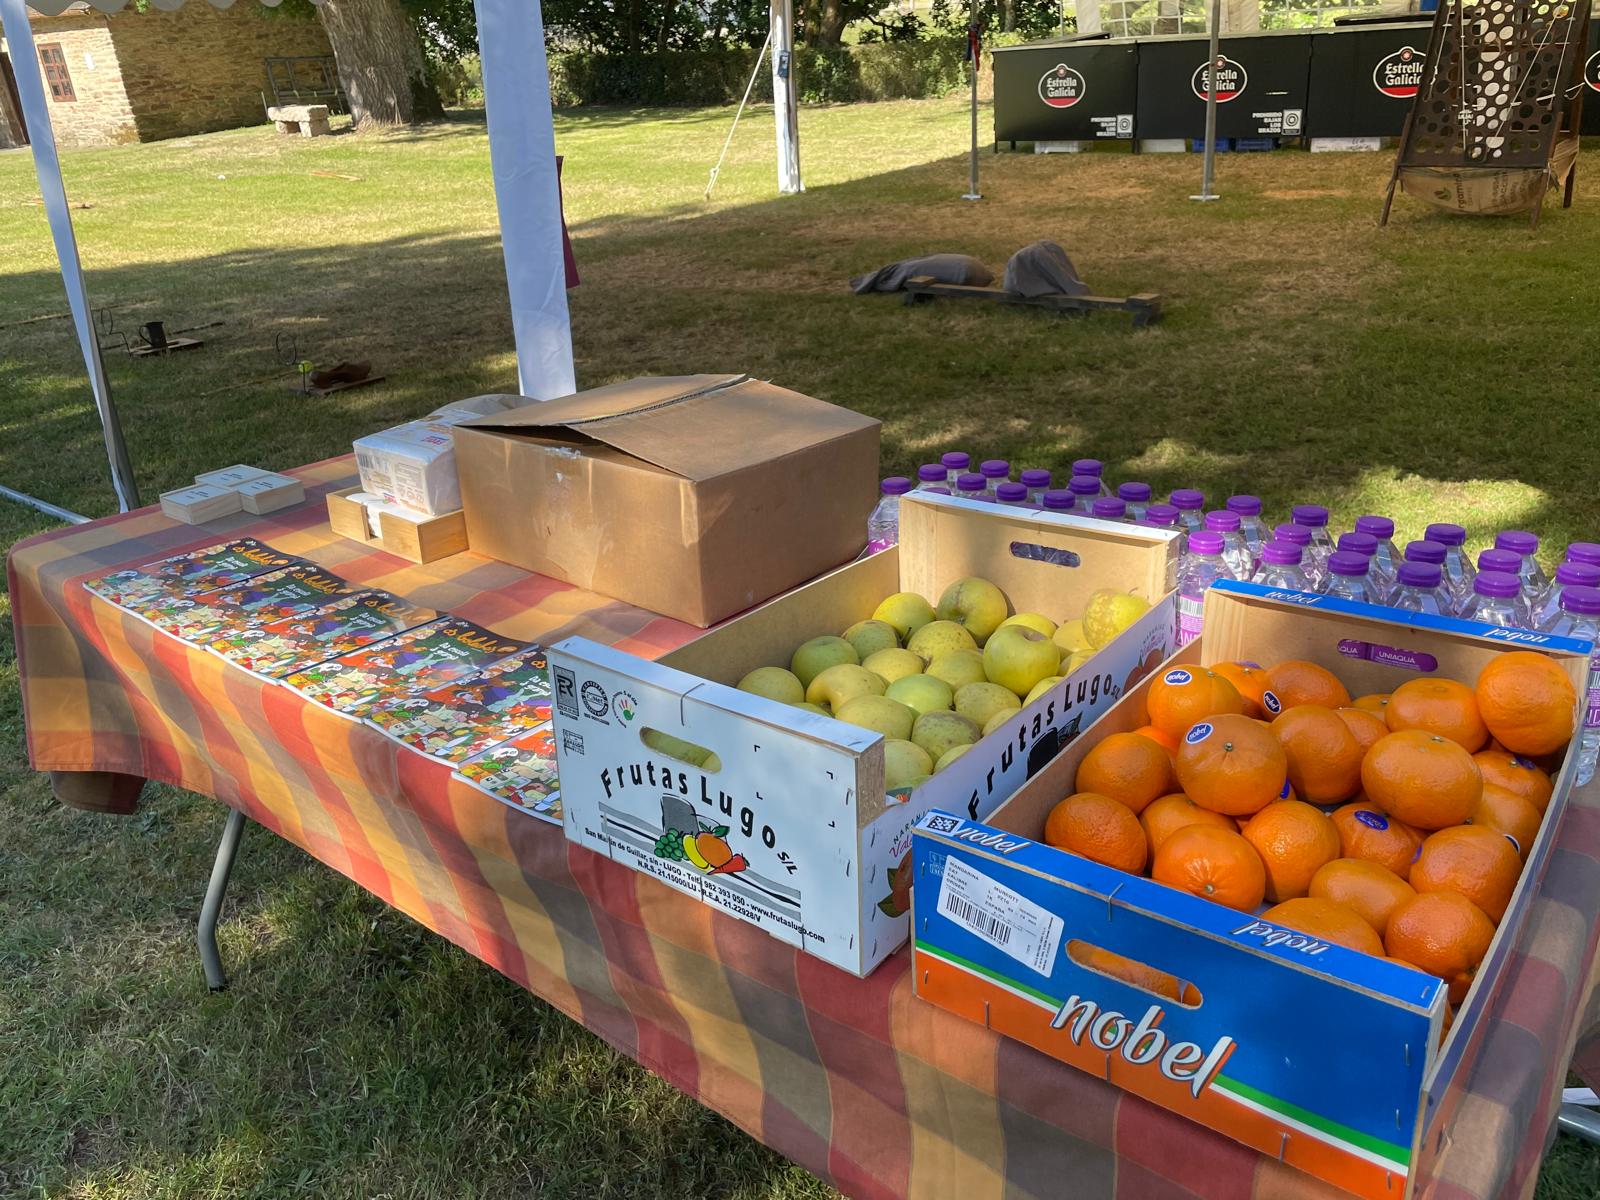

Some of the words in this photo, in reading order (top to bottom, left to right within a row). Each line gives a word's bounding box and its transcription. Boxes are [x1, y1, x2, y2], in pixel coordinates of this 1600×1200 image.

[1046, 77, 1077, 87] Estrella
[1201, 70, 1238, 80] Erella
[1047, 87, 1076, 97] Galicia
[1202, 80, 1236, 91] Glicia
[1266, 591, 1322, 605] nobel
[1485, 628, 1550, 643] nobel
[1378, 651, 1416, 664] UNIAQUA
[967, 700, 1056, 821] Frutas
[1063, 674, 1113, 713] Lugo
[600, 761, 688, 799] Frutas
[700, 775, 776, 849] Lugo
[955, 827, 1031, 855] nobel
[637, 859, 657, 874] N.R.S.
[585, 827, 596, 839] San
[617, 843, 625, 851] de
[663, 862, 682, 876] LUGO
[704, 881, 717, 891] 982
[718, 887, 731, 898] 393
[732, 894, 745, 906] 050
[750, 903, 825, 943] www.frutaslugo.com
[1230, 921, 1331, 955] nobel
[1050, 994, 1237, 1099] nobel
